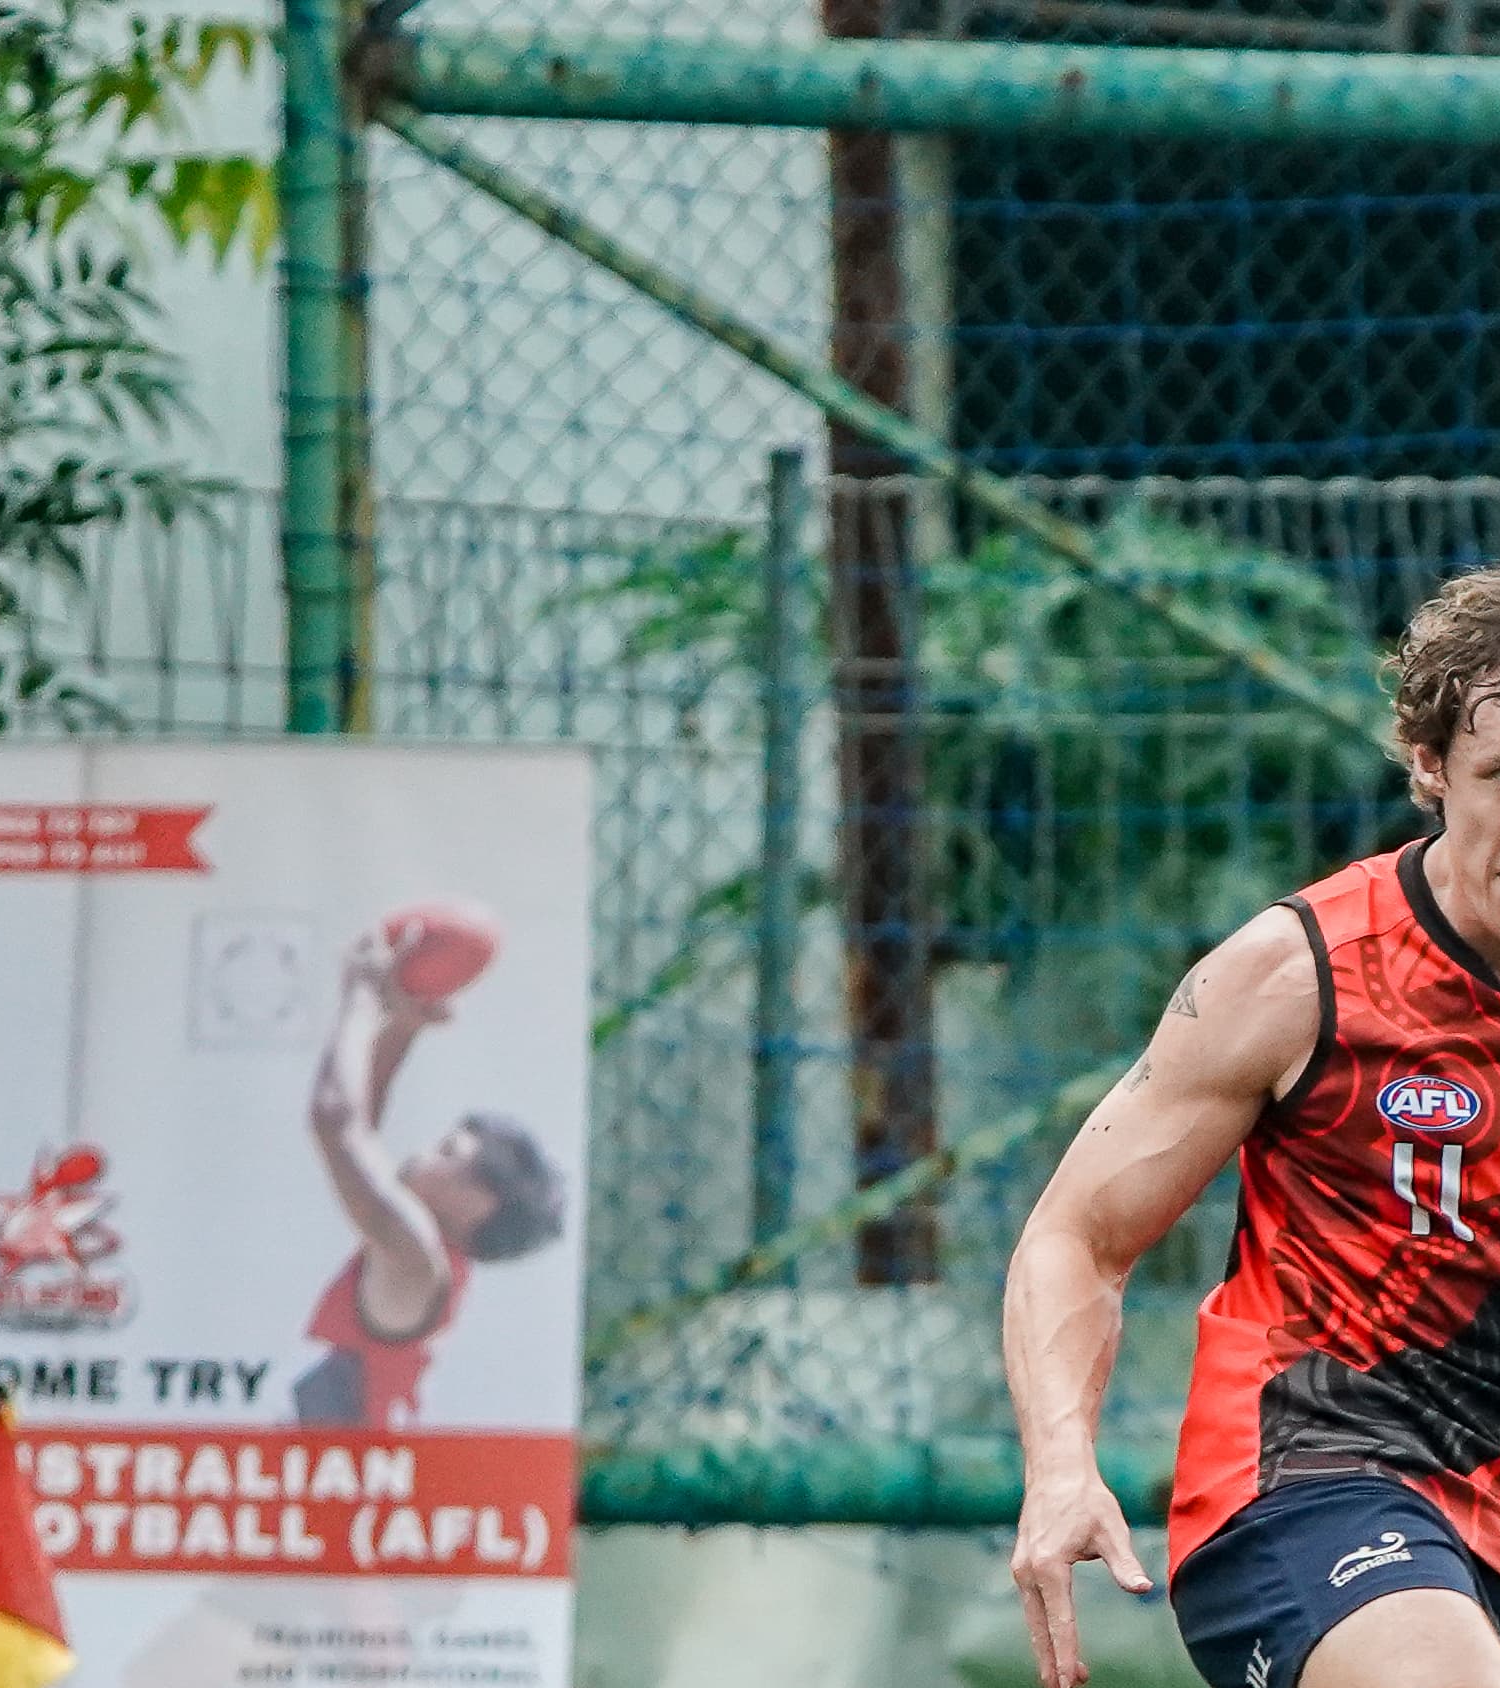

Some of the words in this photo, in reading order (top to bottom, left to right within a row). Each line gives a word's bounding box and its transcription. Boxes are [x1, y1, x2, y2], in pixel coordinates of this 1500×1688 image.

[1387, 1087, 1472, 1118] AFL
[1392, 1141, 1476, 1243] 11
[146, 1359, 269, 1403] TRY
[349, 1501, 552, 1569] (AFL)
[1330, 1547, 1414, 1588] tsunami
